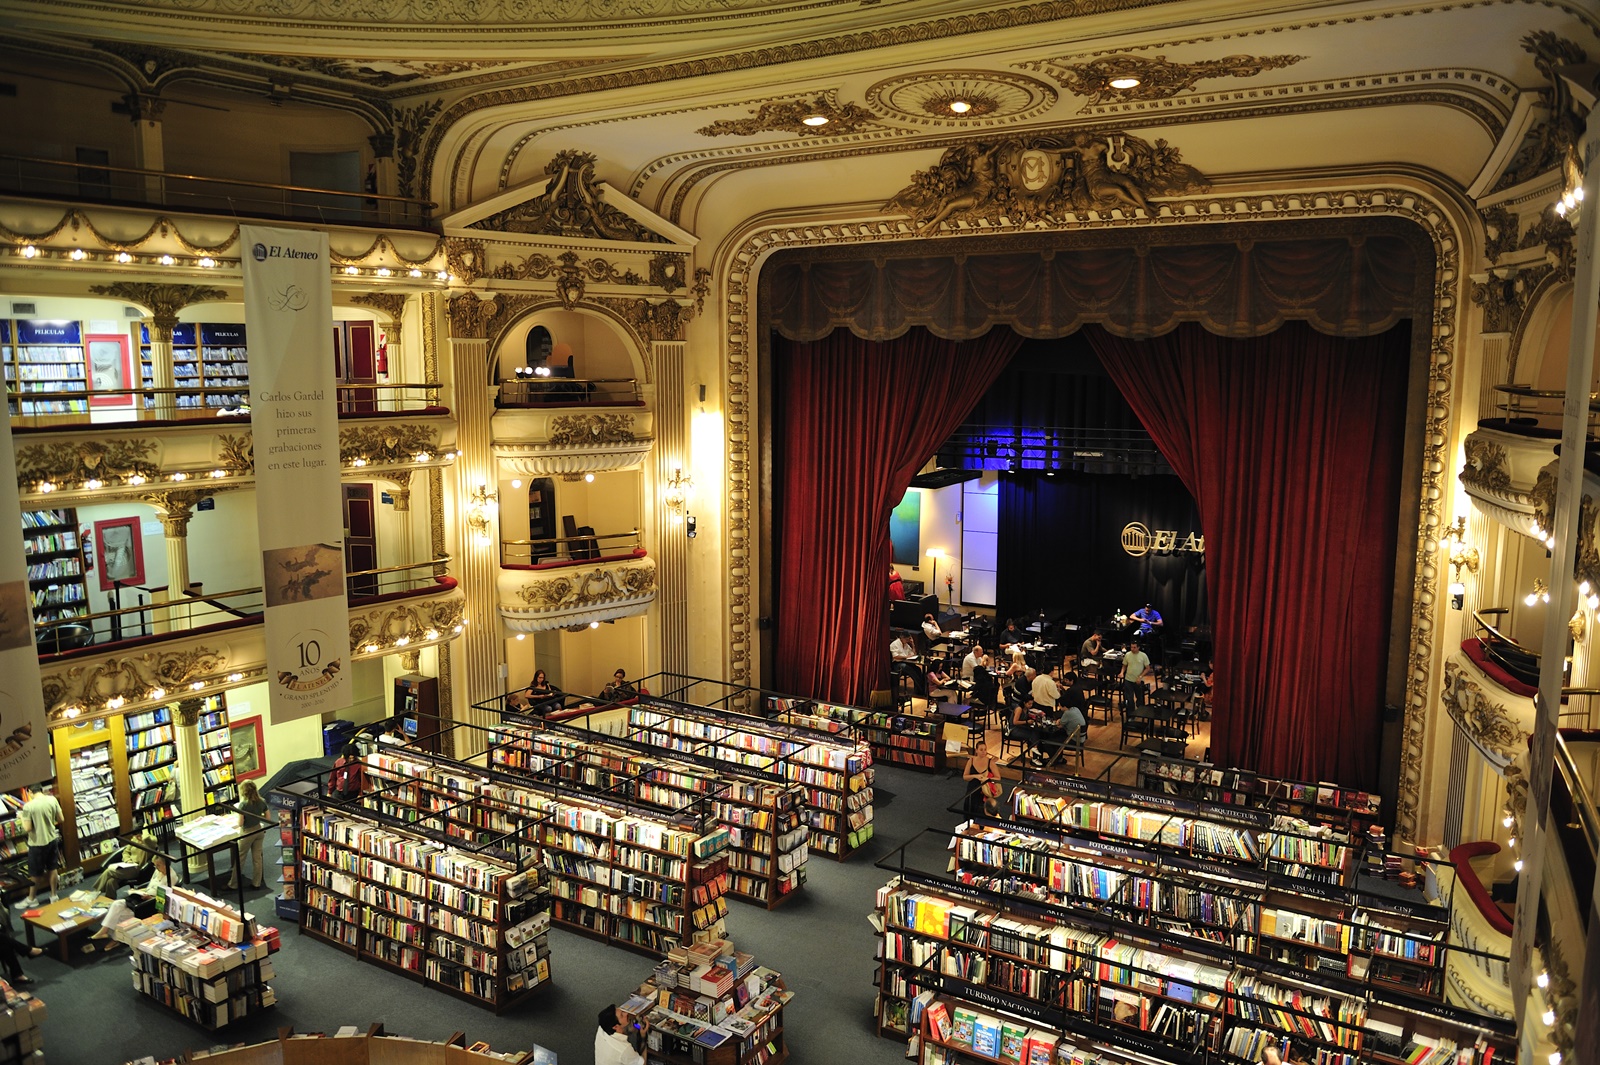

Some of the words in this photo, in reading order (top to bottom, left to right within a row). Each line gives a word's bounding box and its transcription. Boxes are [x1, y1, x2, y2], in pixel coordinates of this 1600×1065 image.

[269, 245, 281, 258] El
[283, 247, 319, 260] Ateneo
[260, 391, 291, 401] Carlos
[293, 390, 324, 401] Gardel
[276, 408, 295, 419] hizo
[276, 426, 316, 438] primeras
[268, 442, 322, 455] grabaciones
[282, 461, 300, 469] este
[302, 457, 327, 469] lugar.
[1150, 530, 1178, 551] El
[296, 640, 321, 669] 10
[300, 666, 320, 677] AÑOS
[284, 693, 309, 701] GRAND
[309, 680, 340, 700] SPLENDID
[1045, 778, 1088, 790] ARQUITECTURA
[282, 797, 296, 807] kier
[1130, 793, 1176, 807] ARQUITECTURA
[1210, 806, 1258, 820] ARQUITECTURA
[1198, 863, 1230, 875] VISUALES
[1291, 883, 1326, 895] VISUALES
[1393, 905, 1413, 914] CINE
[964, 987, 1000, 1004] TURISMO
